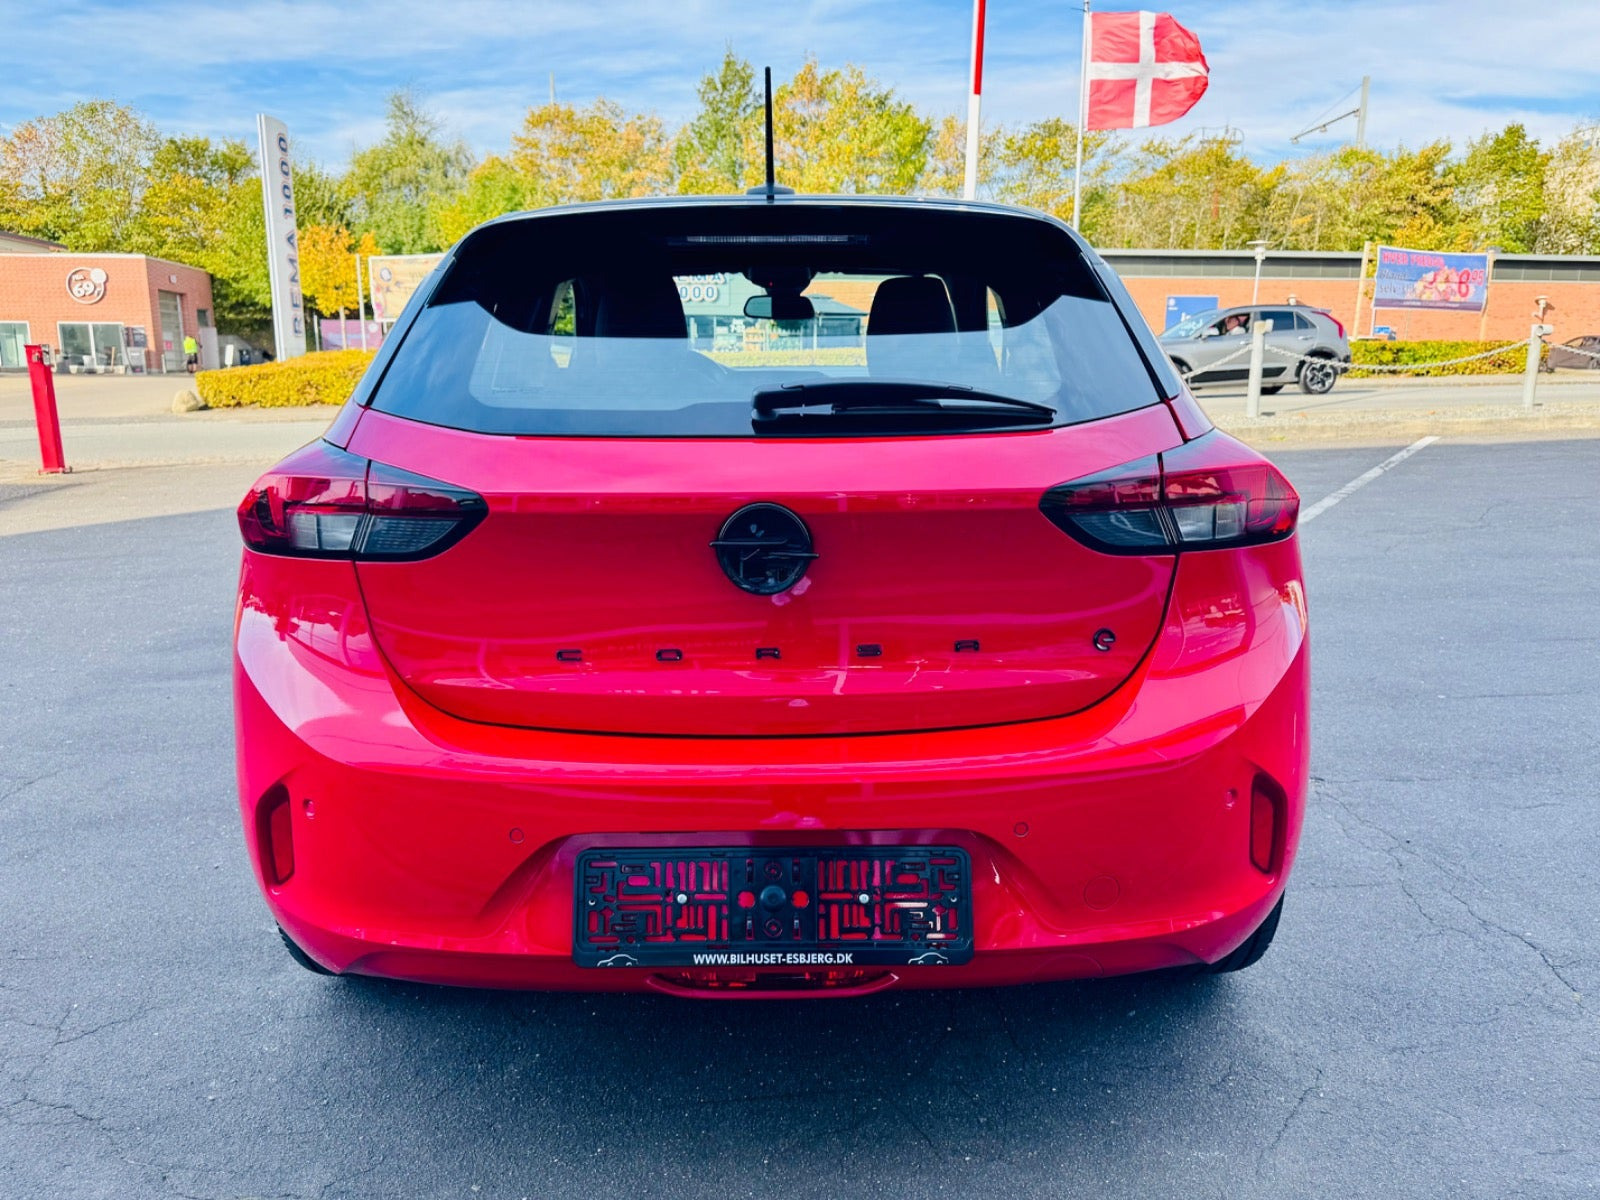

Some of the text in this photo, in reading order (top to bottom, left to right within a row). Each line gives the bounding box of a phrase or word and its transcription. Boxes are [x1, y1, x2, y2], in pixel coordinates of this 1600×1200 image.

[277, 133, 302, 337] REMA 1000
[679, 285, 717, 301] 000
[556, 639, 980, 662] CORSA
[693, 953, 854, 965] WWW.BILHUSET-ESBJERG.DK
